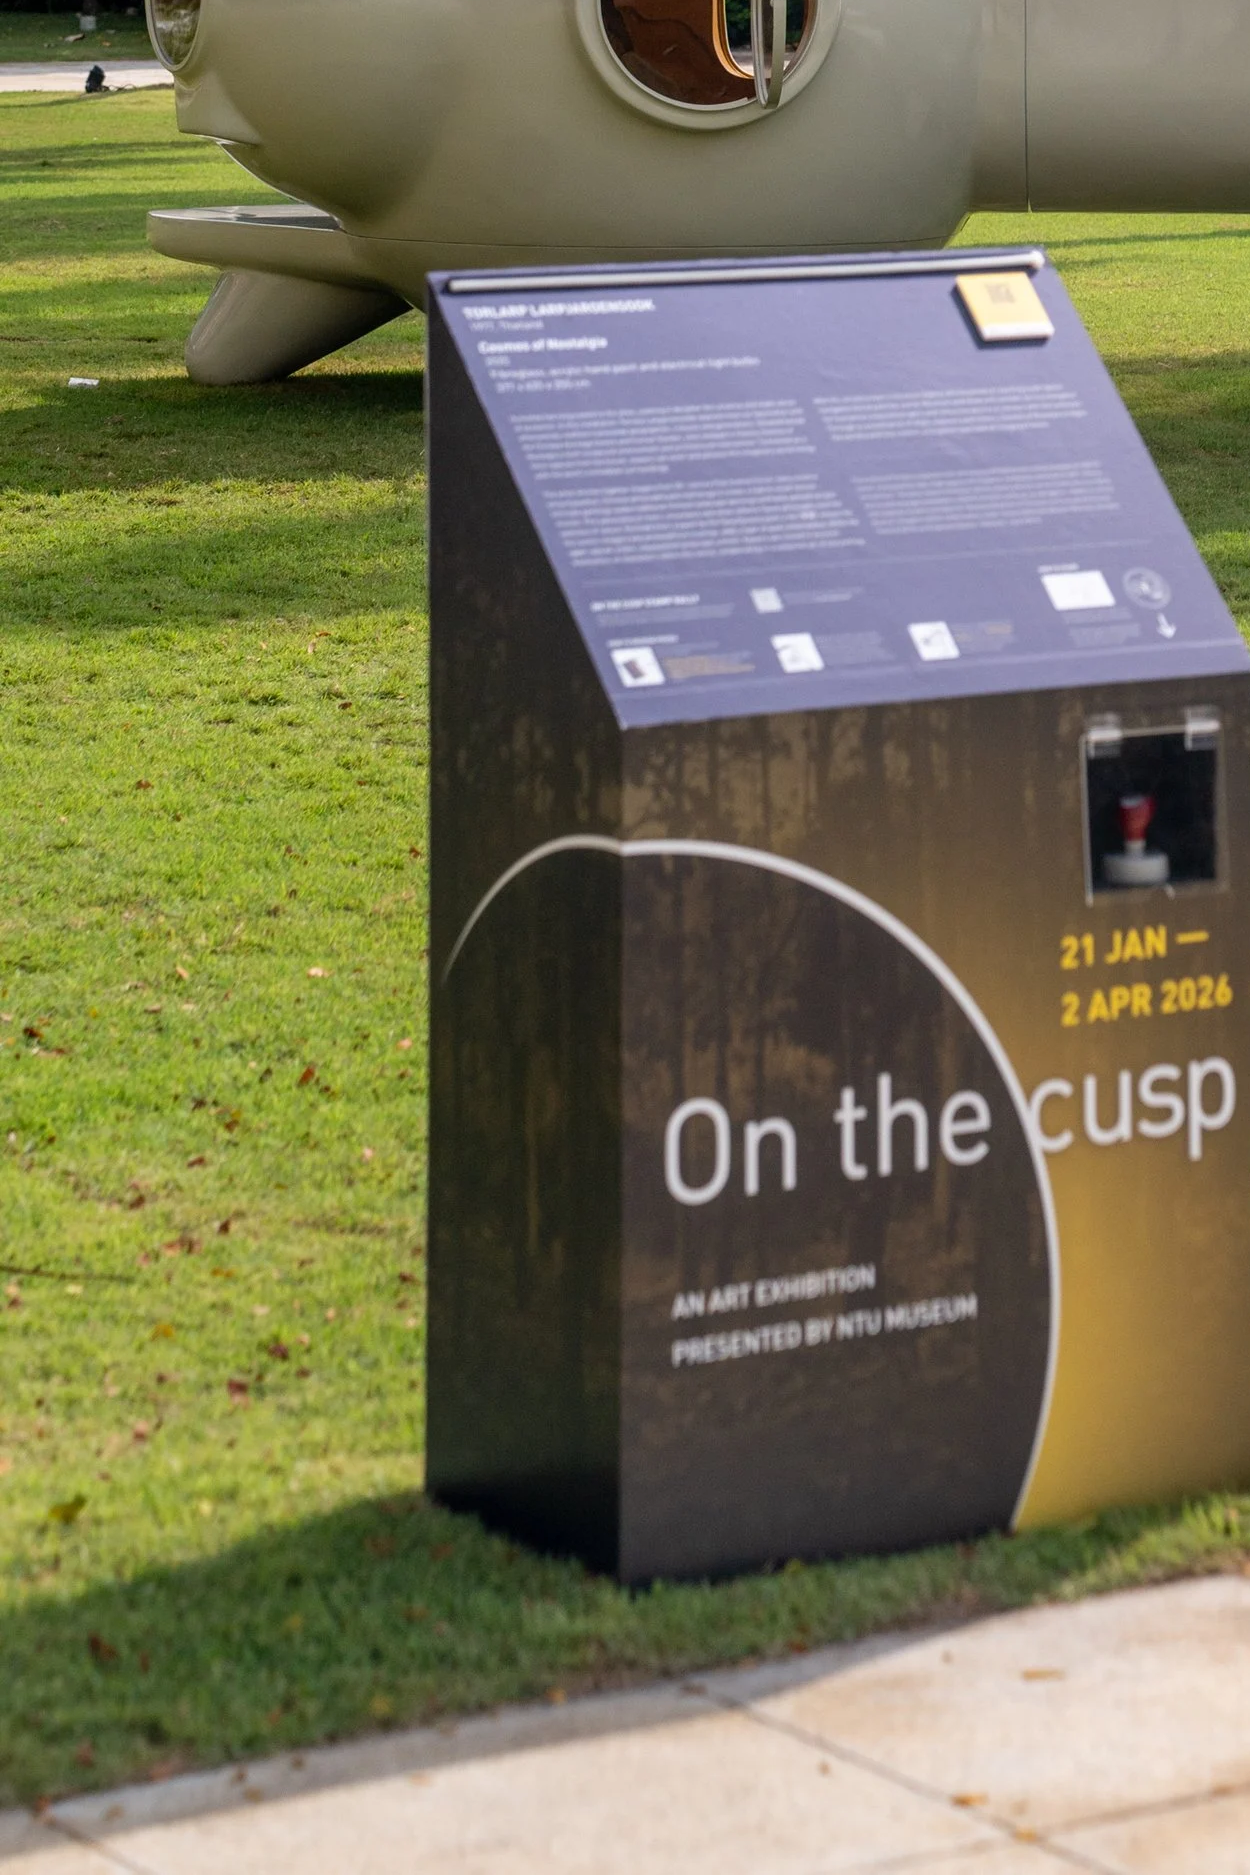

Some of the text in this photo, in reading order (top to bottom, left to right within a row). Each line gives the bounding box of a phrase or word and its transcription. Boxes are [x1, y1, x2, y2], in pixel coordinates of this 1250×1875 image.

[1060, 932, 1095, 970] 21
[1104, 924, 1167, 965] JAN
[1060, 972, 1233, 1027] 2 APR 2026
[664, 1056, 1236, 1205] On the cusp
[671, 1262, 877, 1321] AN ART EXHIBITION
[671, 1291, 979, 1369] PRESENTED BY NTU MUSEUM
